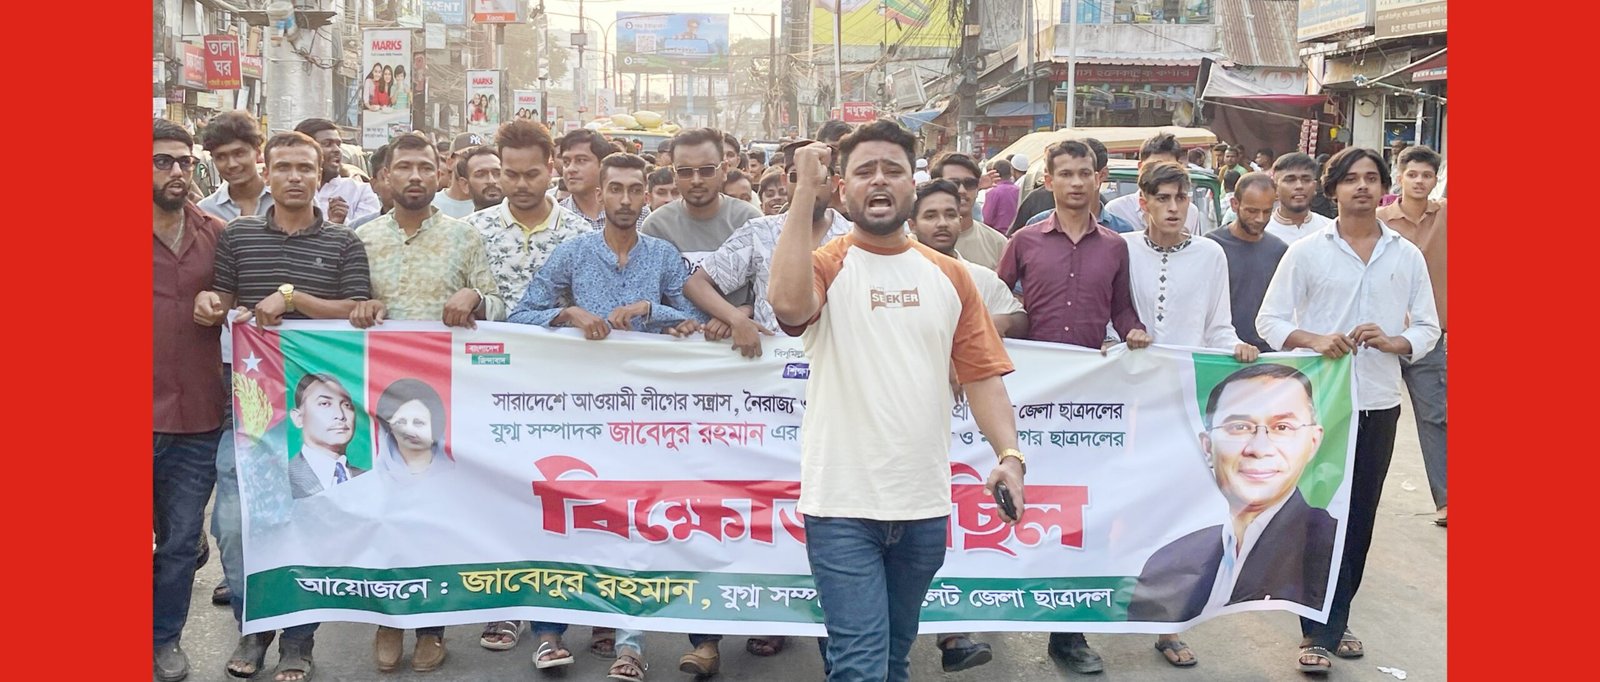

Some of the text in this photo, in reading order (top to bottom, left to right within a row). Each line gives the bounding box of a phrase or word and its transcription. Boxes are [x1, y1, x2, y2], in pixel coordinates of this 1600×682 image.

[206, 39, 236, 56] তালা
[371, 40, 402, 50] MARKS
[212, 60, 232, 77] ঘর
[472, 77, 494, 85] MARKS
[871, 293, 919, 303] SEEKER
[491, 391, 568, 412] সারাদেশে
[571, 386, 637, 411] আওয়ামী
[640, 386, 690, 412] লীগের
[743, 389, 797, 414] নৈরাজ্য
[1018, 401, 1055, 420] জেলা
[1059, 401, 1124, 422] ছাত্রদলের
[489, 420, 800, 451] যুগ্ম সম্পাদক জাবেদুর রহমান এর
[959, 430, 974, 445] ও
[1048, 429, 1126, 447] ছাত্রদলের
[295, 576, 432, 600] আয়োজনে
[458, 568, 588, 600] জাবেদুর
[718, 583, 764, 611] যুগ্ম
[969, 587, 1025, 608] জেলা
[1030, 587, 1114, 611] ছাত্রদল
